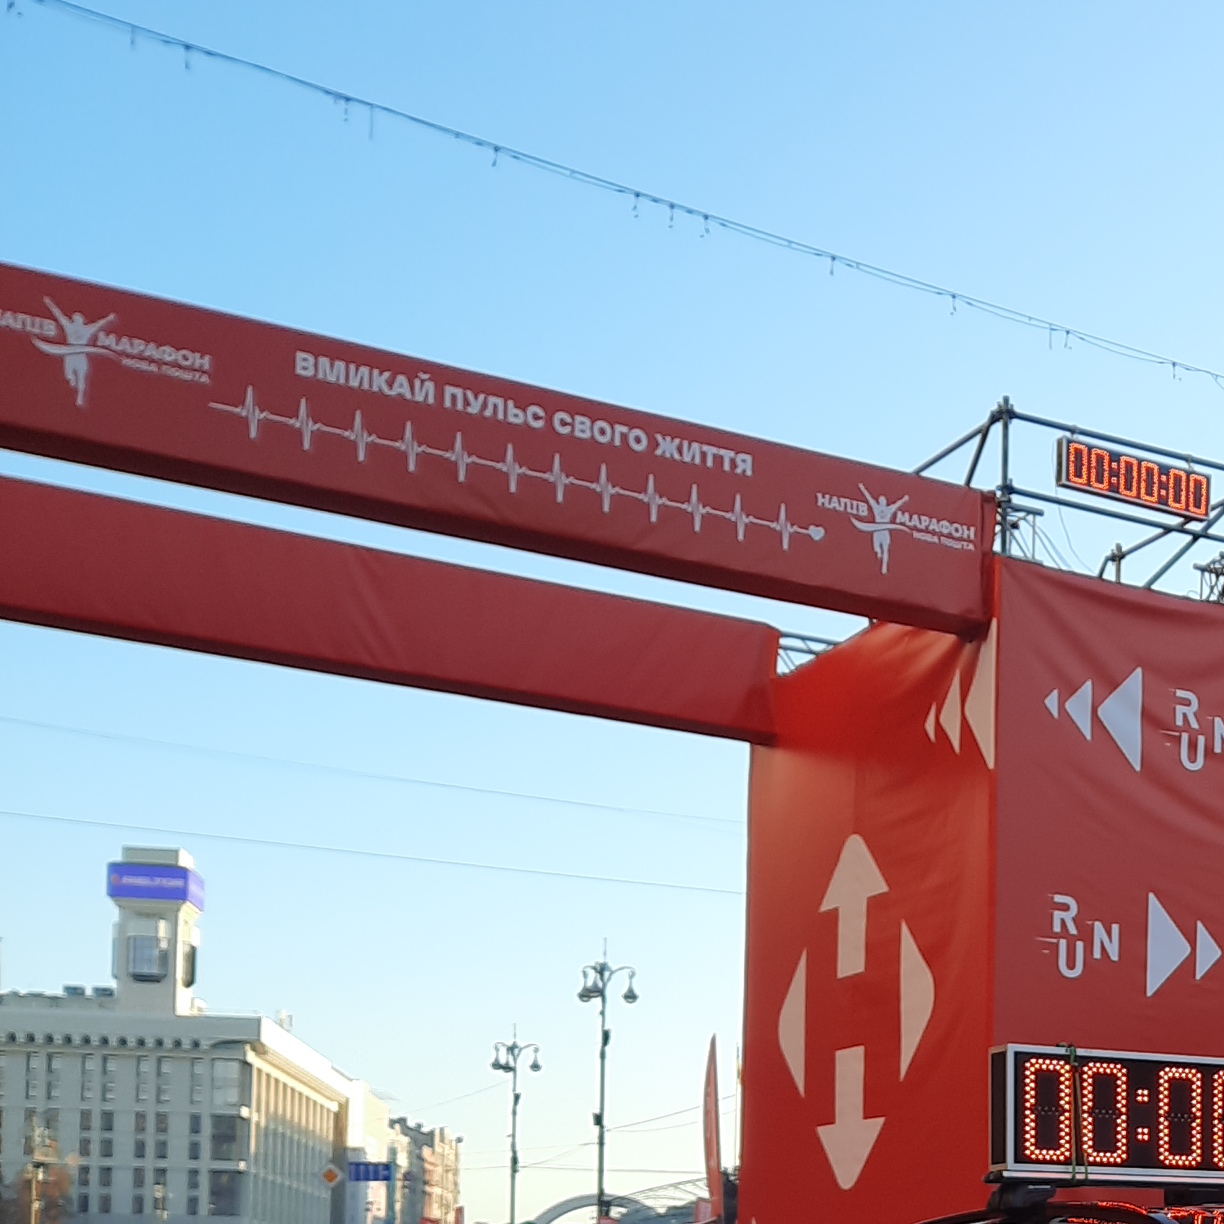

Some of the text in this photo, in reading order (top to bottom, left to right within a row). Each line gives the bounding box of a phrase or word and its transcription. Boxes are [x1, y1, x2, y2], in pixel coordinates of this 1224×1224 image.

[0, 309, 58, 337] АПІВ
[97, 331, 212, 370] МАРАФОН
[295, 350, 754, 477] ВМИКАЙ ПУЛЬС СВОГО ЖИТТЯ
[1069, 442, 1208, 516] 00:00:00
[816, 492, 869, 517] НАПІВ
[895, 510, 976, 541] МАРАФОН
